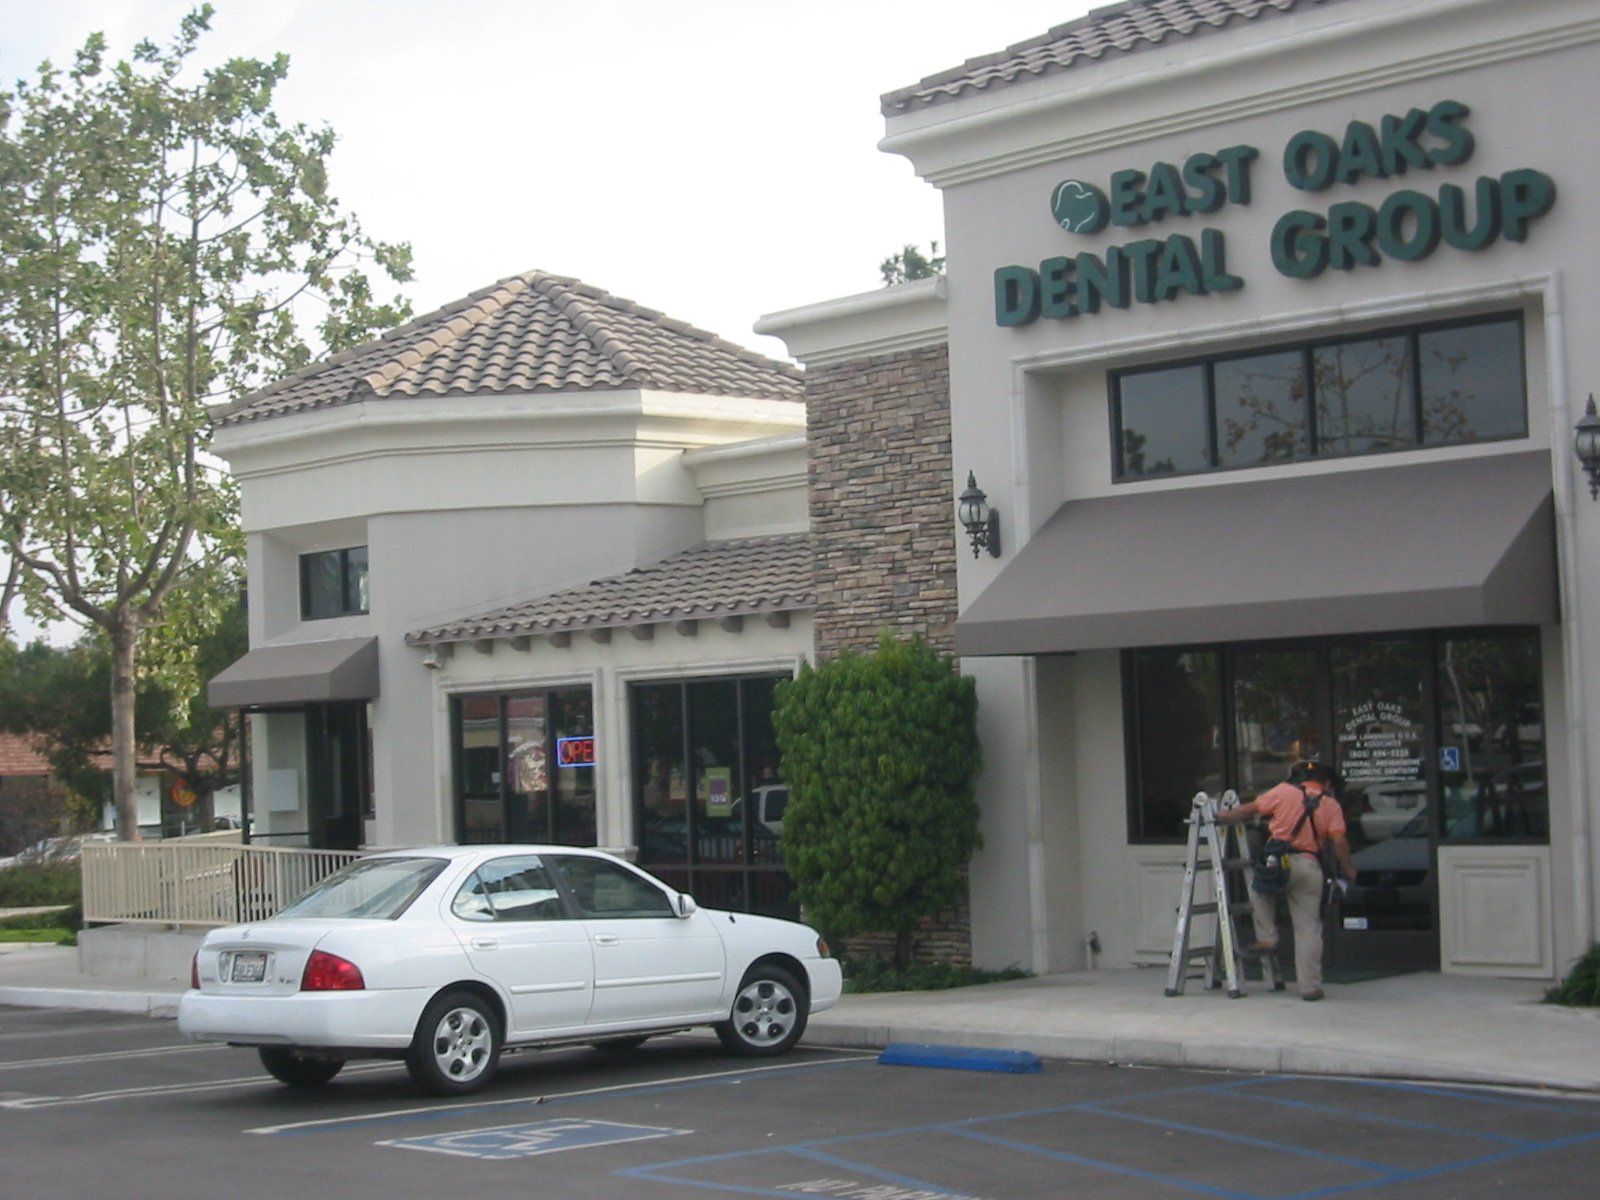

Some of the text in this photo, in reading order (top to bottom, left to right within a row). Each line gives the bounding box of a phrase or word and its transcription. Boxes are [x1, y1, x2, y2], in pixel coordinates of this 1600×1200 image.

[1110, 99, 1475, 227] EAST OAKS
[994, 168, 1556, 327] DENTAL GROUP
[1352, 702, 1402, 716] EAST OAKS
[1345, 712, 1411, 731] DENTAL GROUP
[560, 740, 594, 763] OPE
